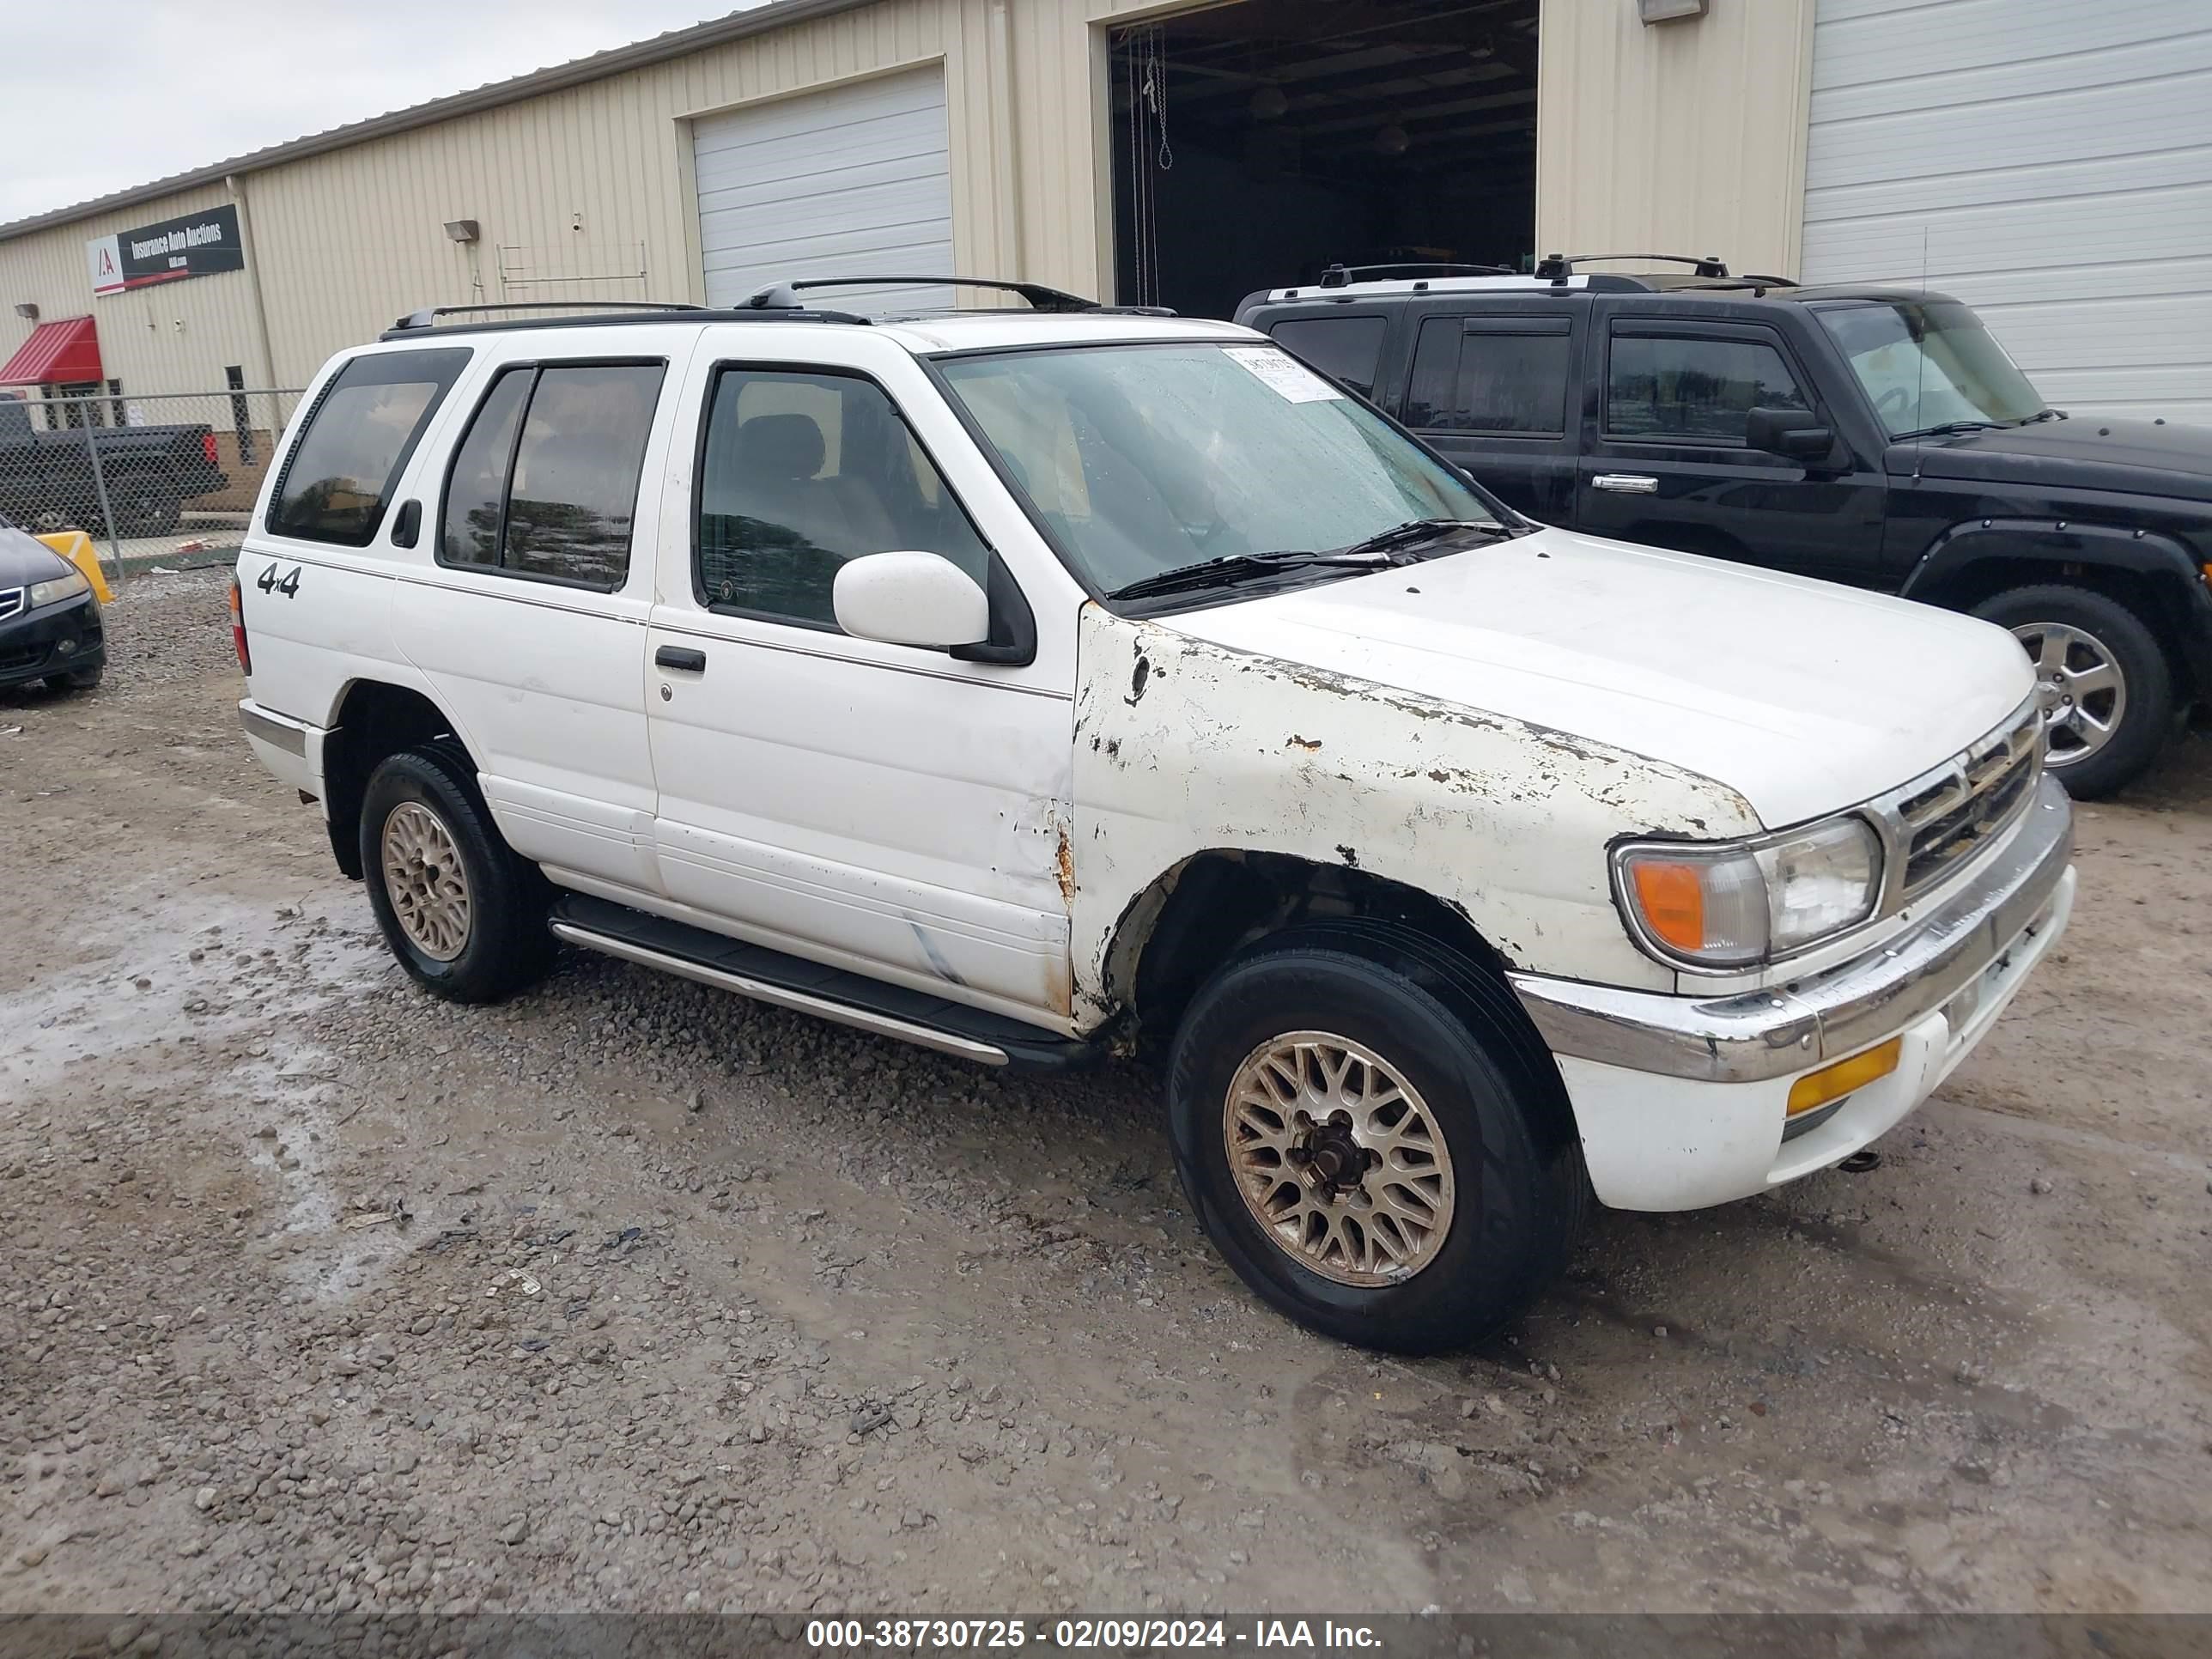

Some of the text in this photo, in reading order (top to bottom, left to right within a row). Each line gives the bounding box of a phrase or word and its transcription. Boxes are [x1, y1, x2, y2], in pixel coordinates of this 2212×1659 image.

[131, 222, 222, 260] Insurance Auto Auctions
[257, 562, 302, 599] 4x4
